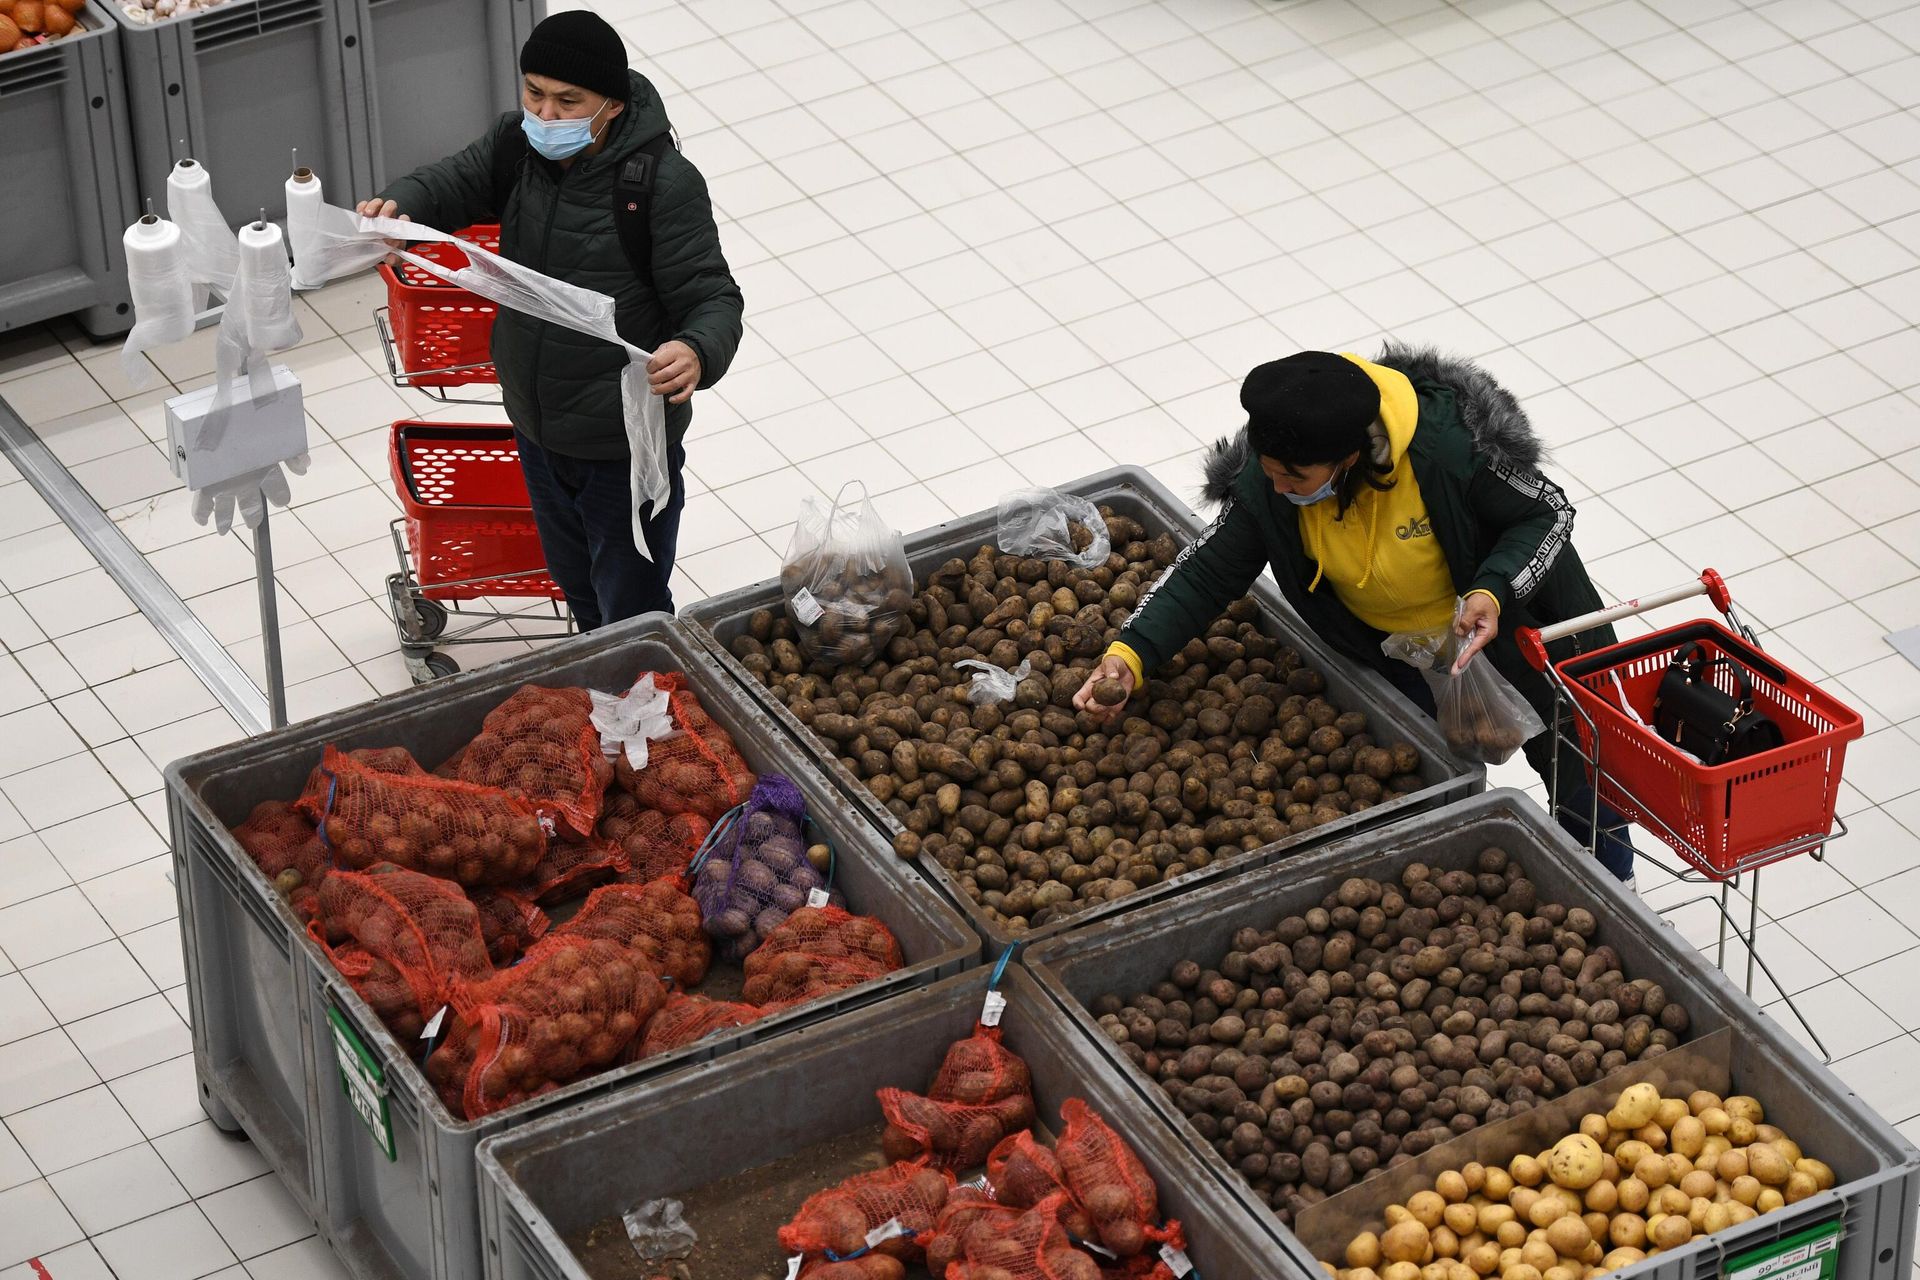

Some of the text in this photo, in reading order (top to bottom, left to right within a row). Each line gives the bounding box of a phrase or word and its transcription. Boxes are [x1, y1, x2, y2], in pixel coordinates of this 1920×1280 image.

[1515, 466, 1540, 487] PARIS
[1537, 532, 1559, 560] MILAN
[1786, 1261, 1818, 1280] БЕЛЫЙ
